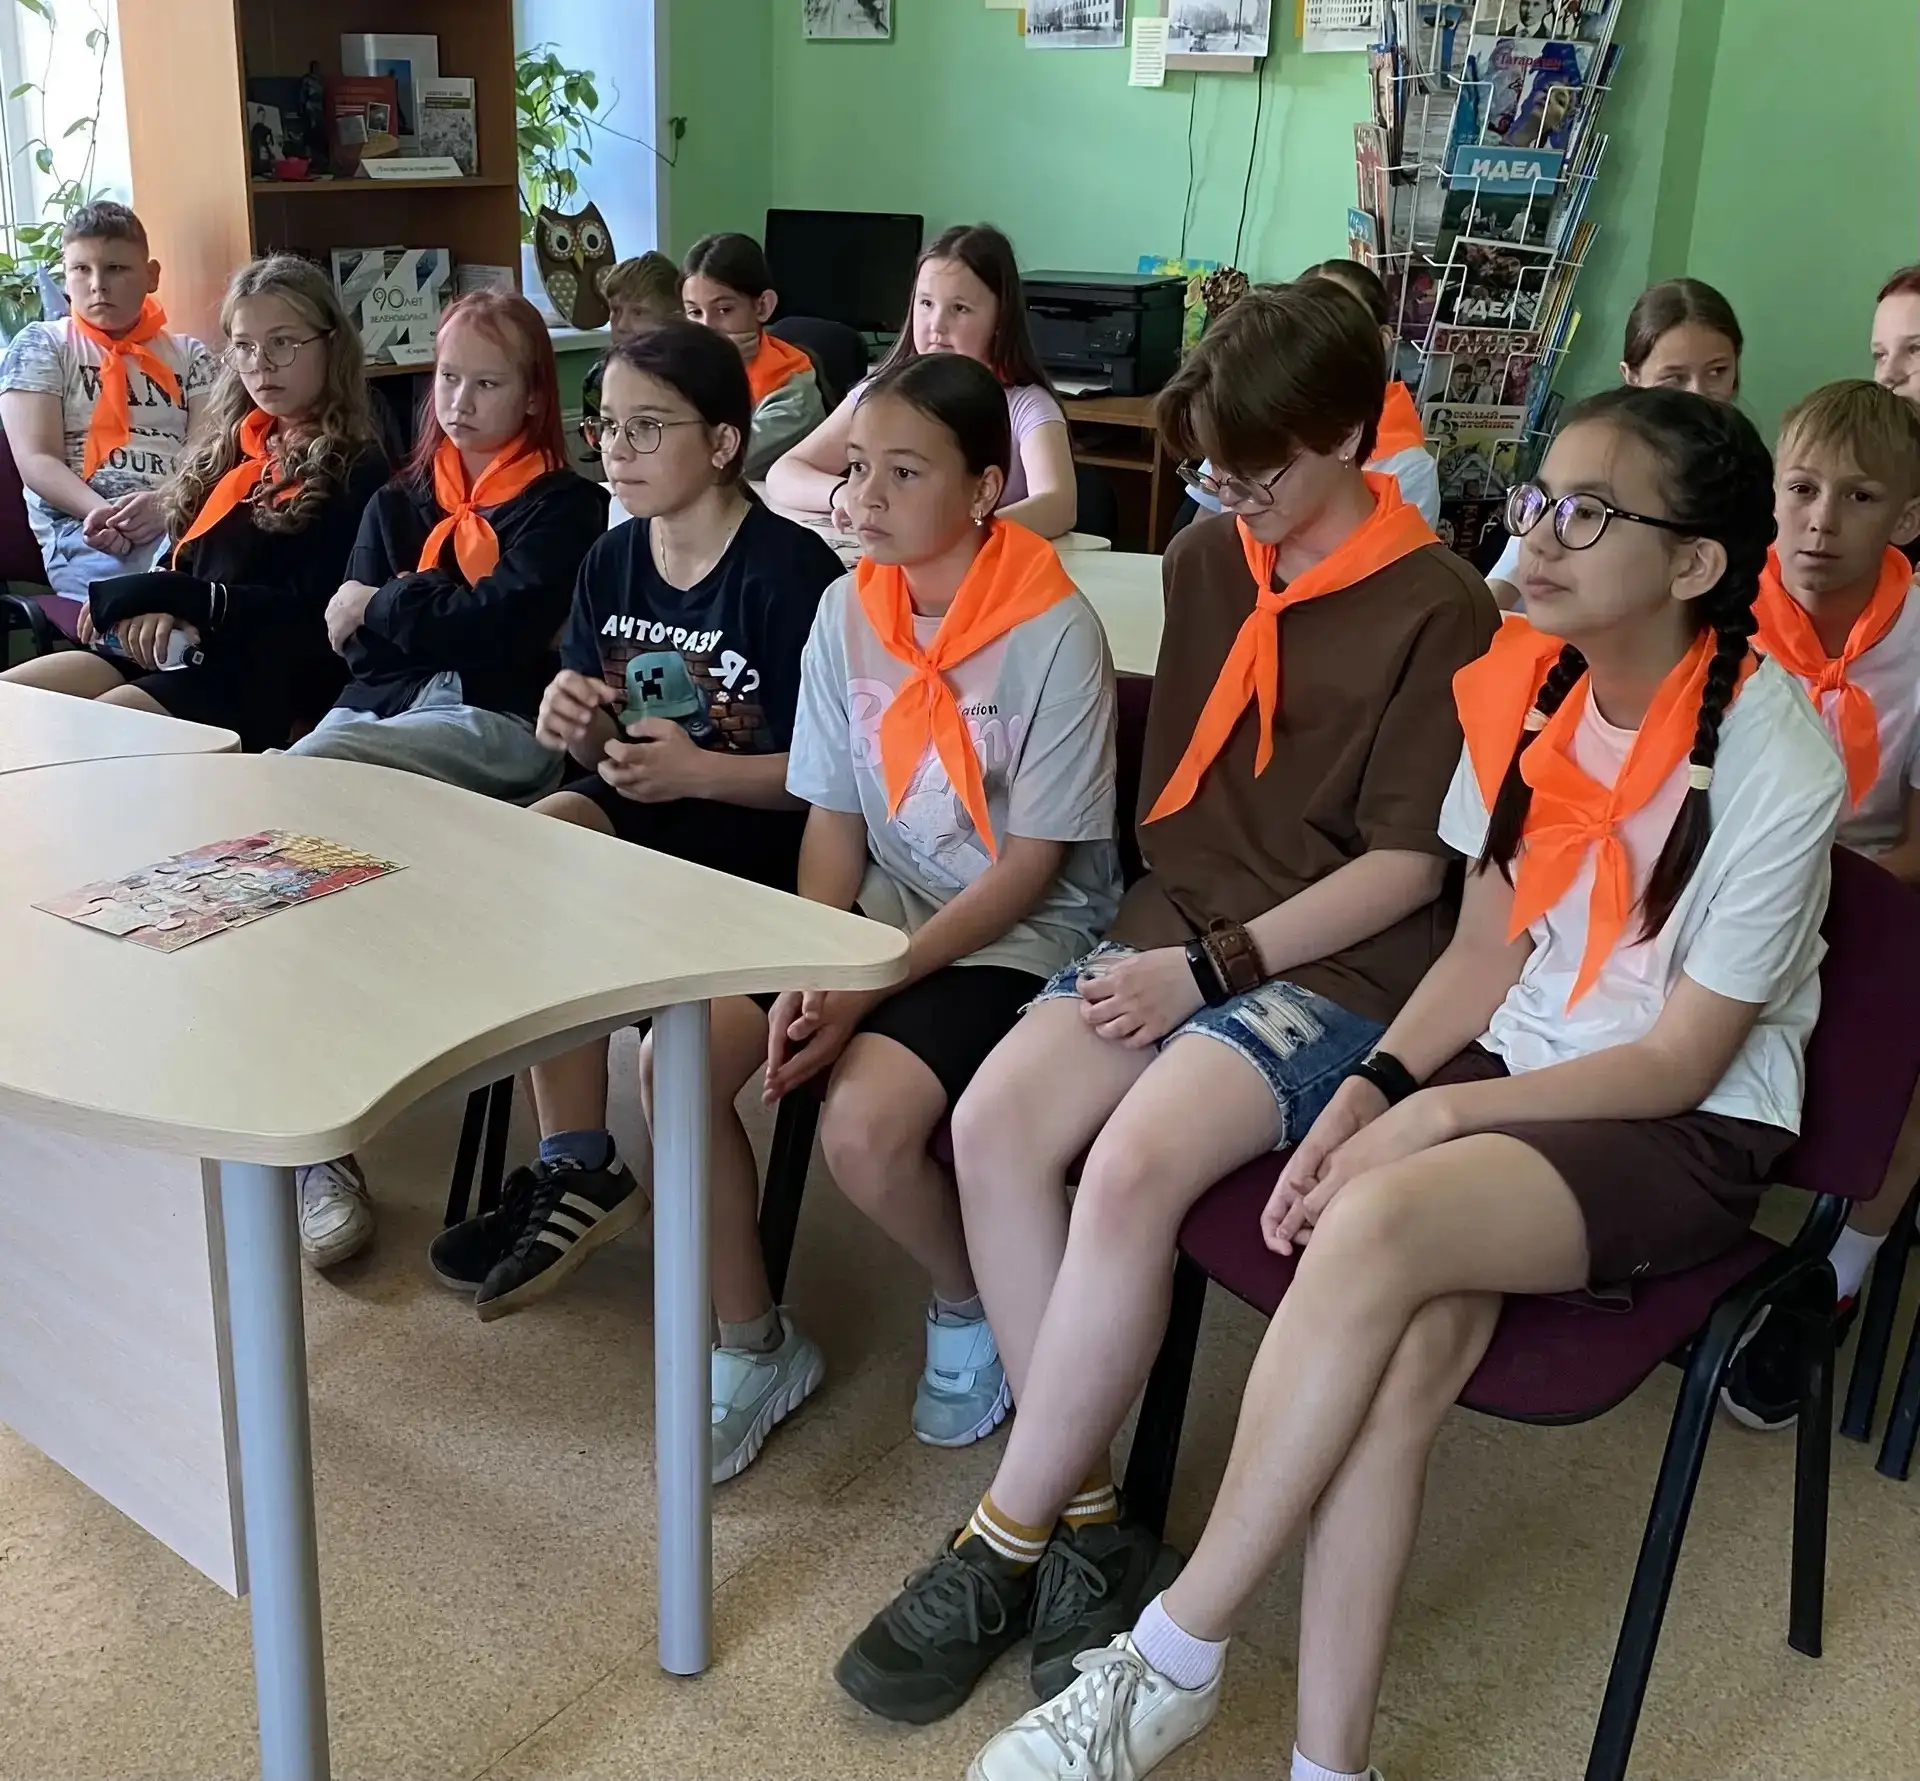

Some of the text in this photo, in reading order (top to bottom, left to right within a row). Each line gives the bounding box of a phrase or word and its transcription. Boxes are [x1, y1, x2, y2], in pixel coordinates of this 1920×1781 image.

[1470, 158, 1542, 182] ИДЕЛ
[372, 286, 405, 311] 90
[1453, 297, 1517, 320] ИДЕЛ
[102, 447, 167, 475] OUR
[957, 702, 998, 717] ation
